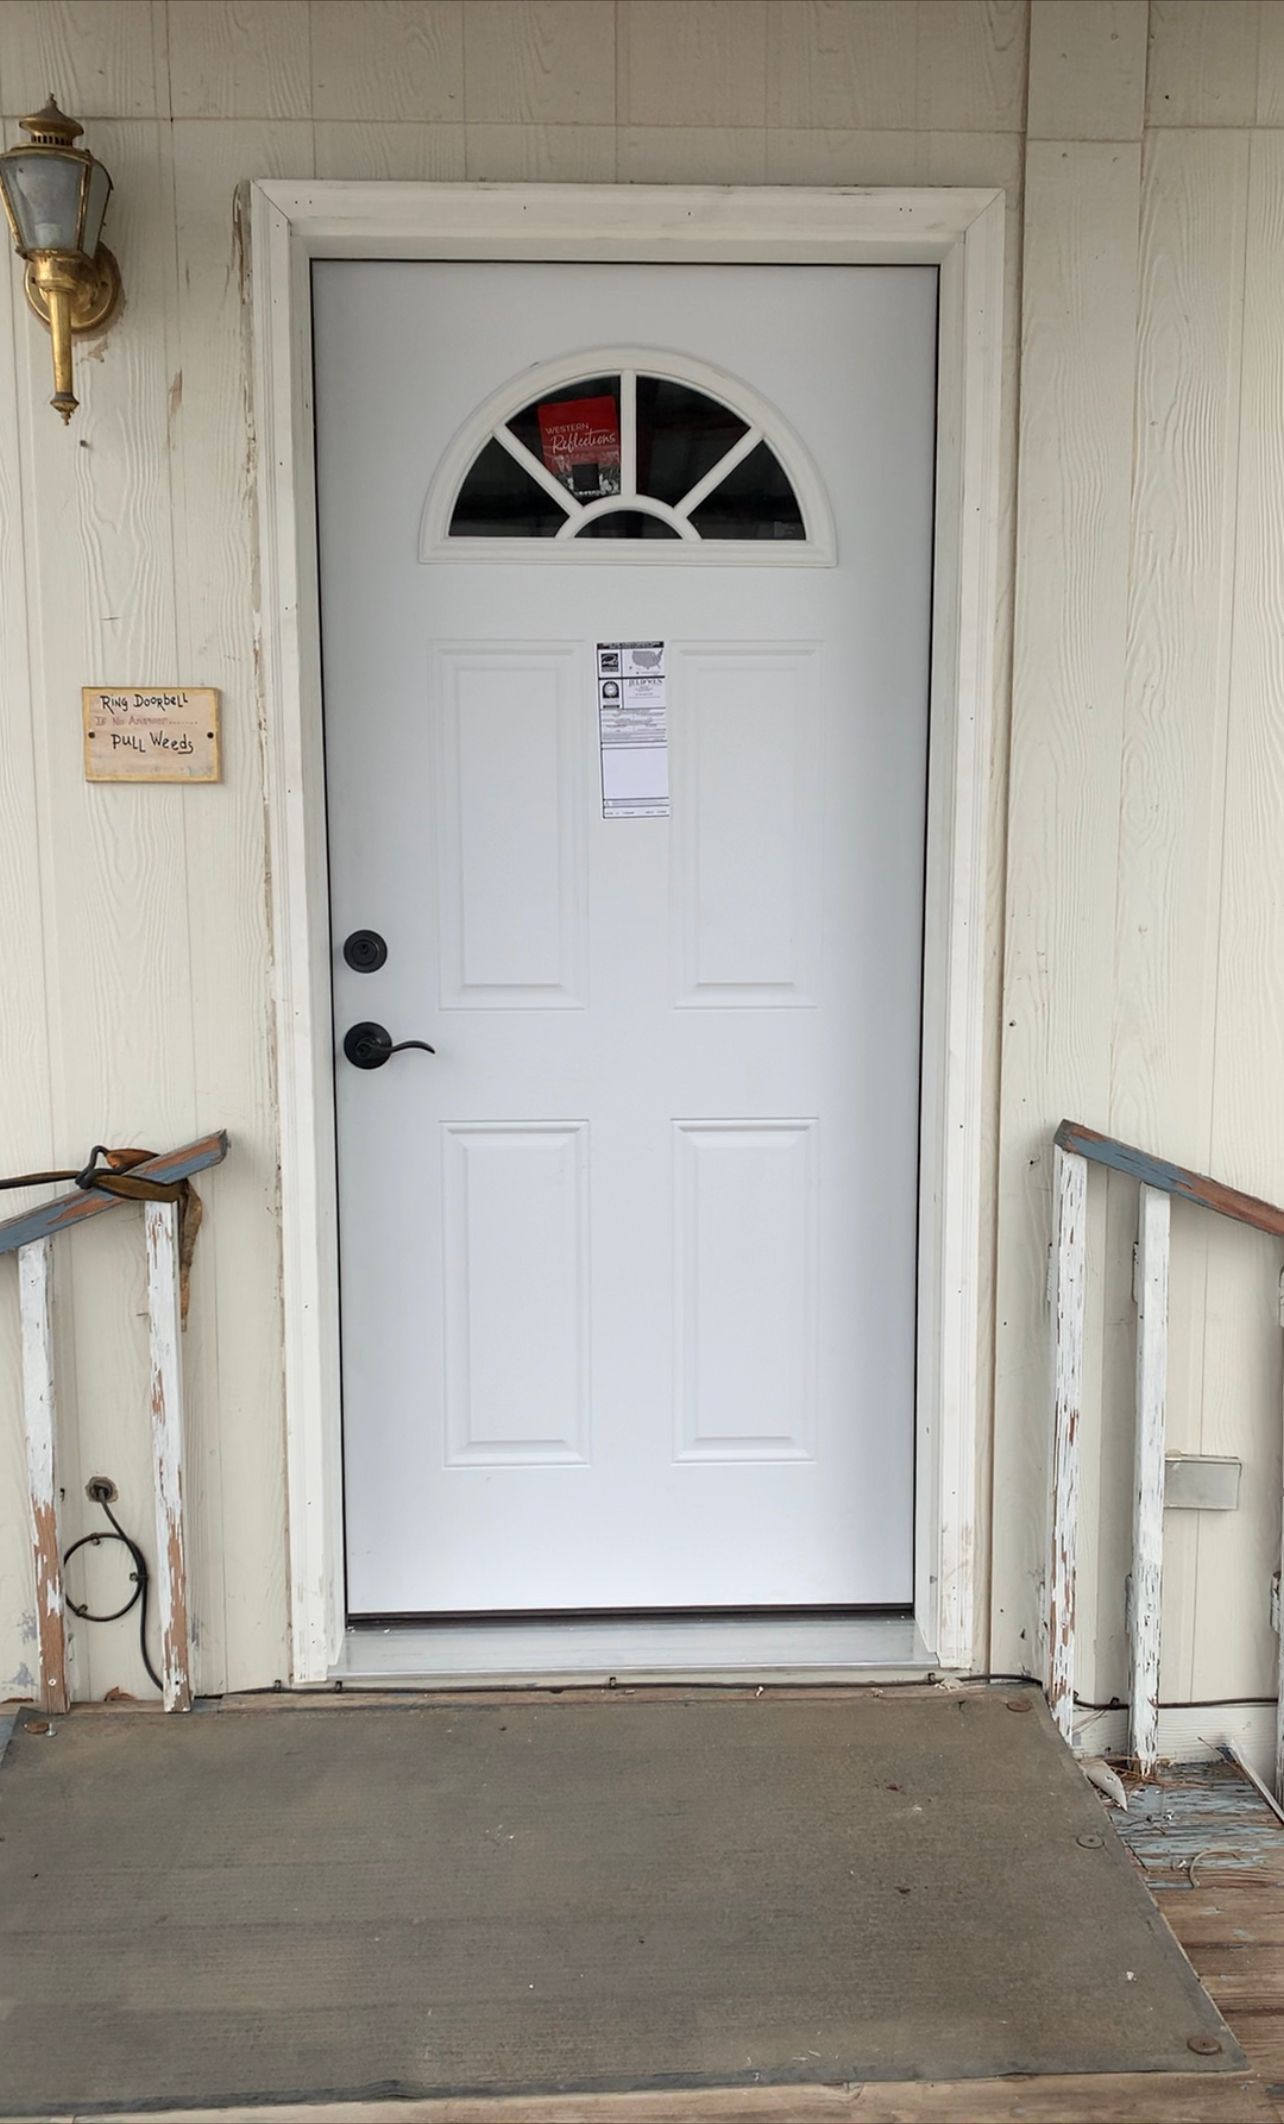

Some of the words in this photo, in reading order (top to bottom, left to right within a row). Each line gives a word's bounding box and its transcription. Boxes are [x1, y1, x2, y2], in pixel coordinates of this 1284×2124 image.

[544, 422, 590, 435] WESTERN
[550, 428, 616, 454] Reflections
[149, 730, 194, 755] Weeds
